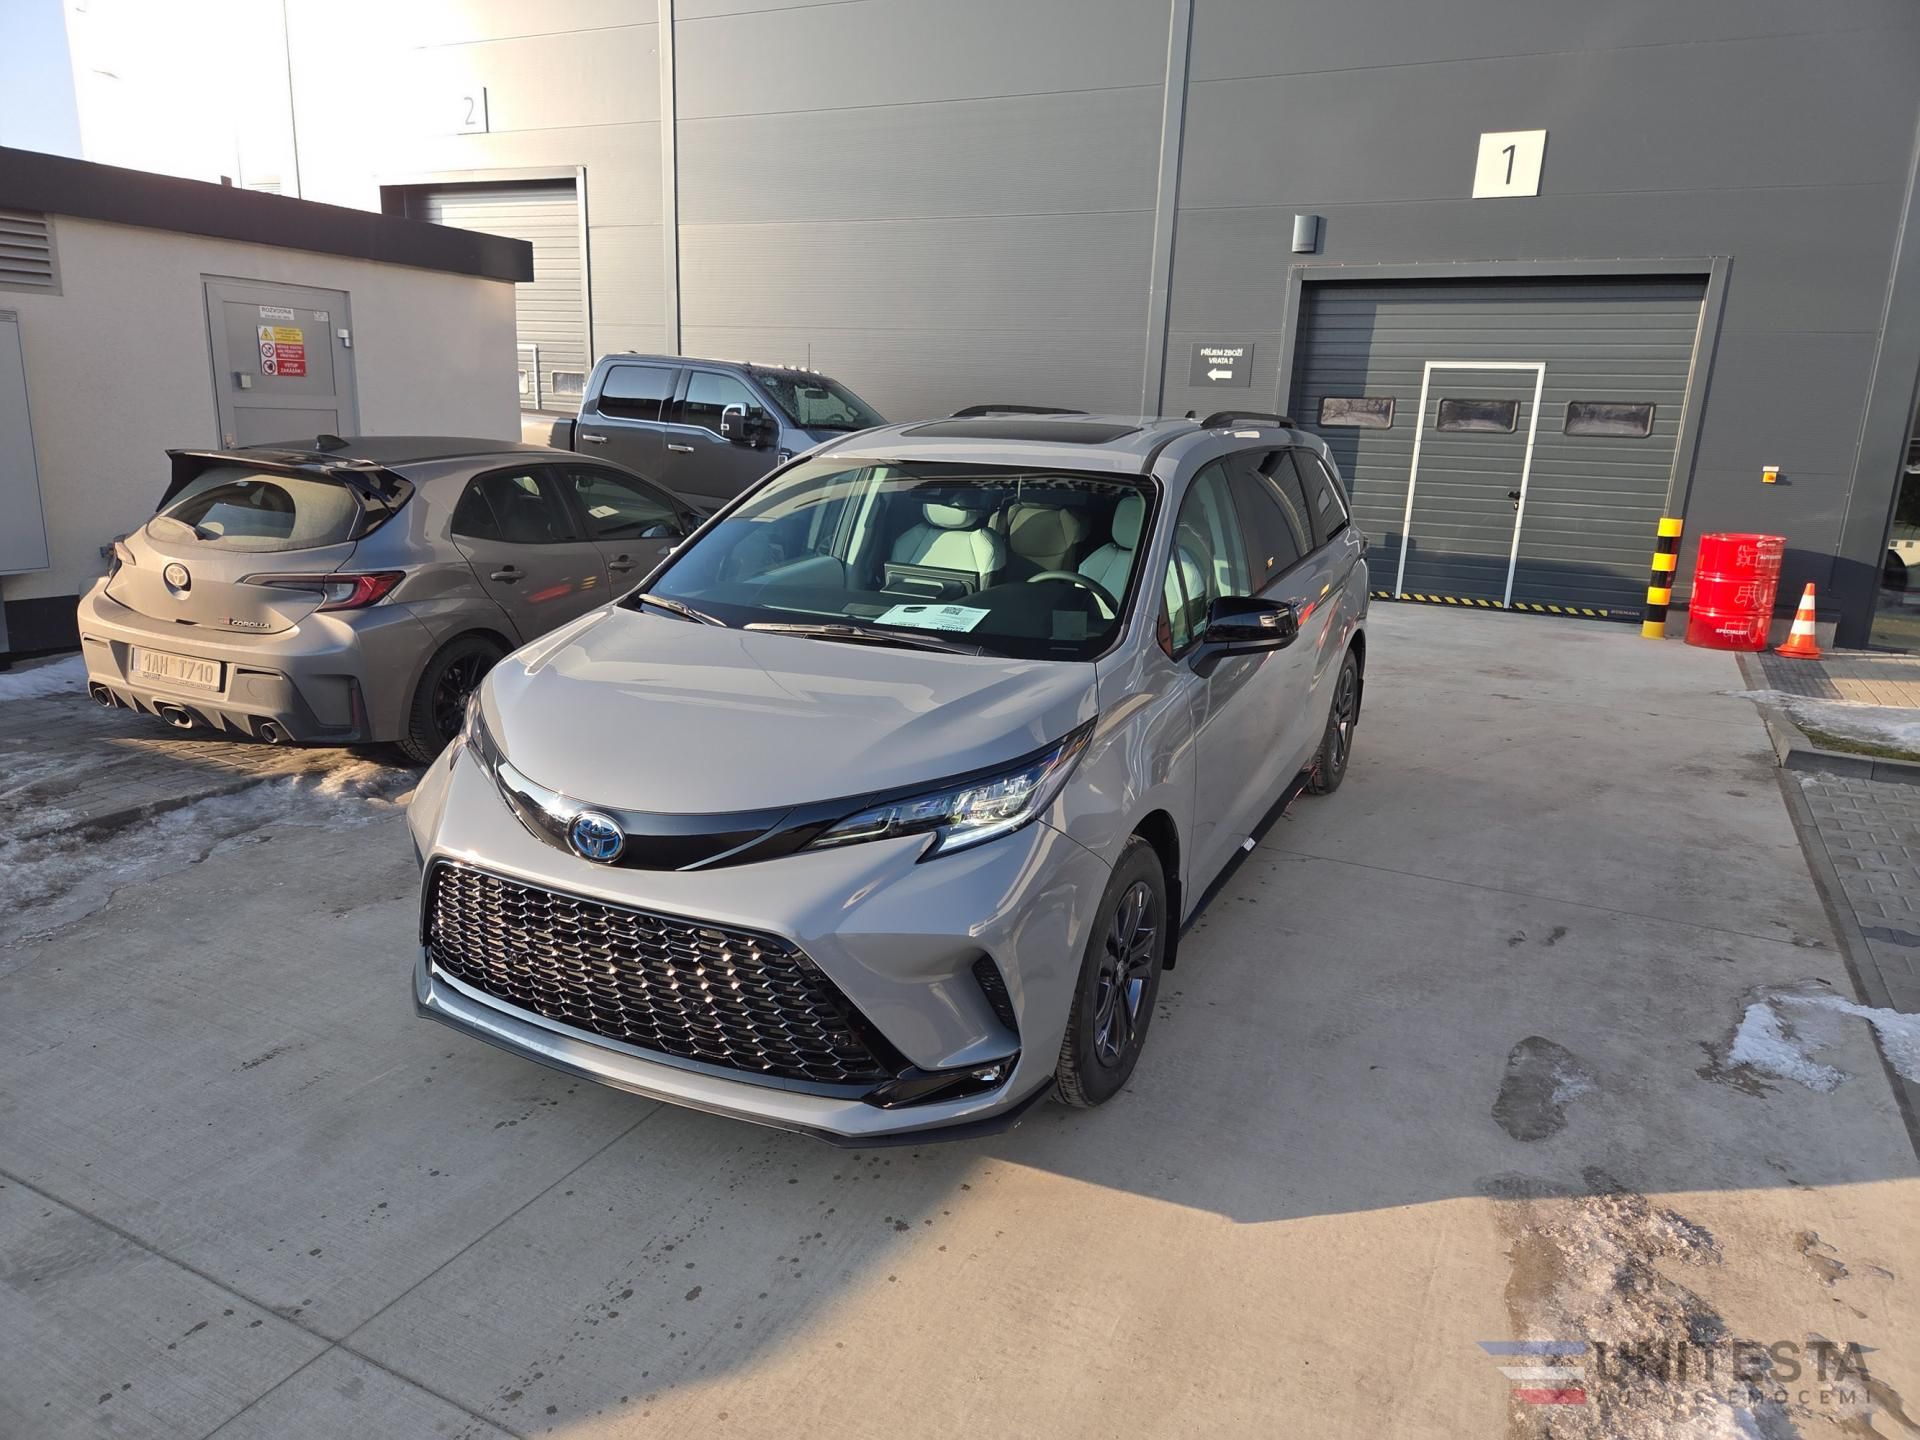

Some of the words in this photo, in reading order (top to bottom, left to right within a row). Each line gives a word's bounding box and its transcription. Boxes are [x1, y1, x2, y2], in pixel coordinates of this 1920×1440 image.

[463, 96, 476, 126] 2
[1502, 144, 1516, 185] 1
[1200, 348, 1223, 356] PŘÍJEM
[1224, 348, 1244, 356] ZBOŽÍ
[231, 619, 271, 629] COROLLA
[144, 652, 169, 675] 1AH
[179, 659, 214, 684] T710
